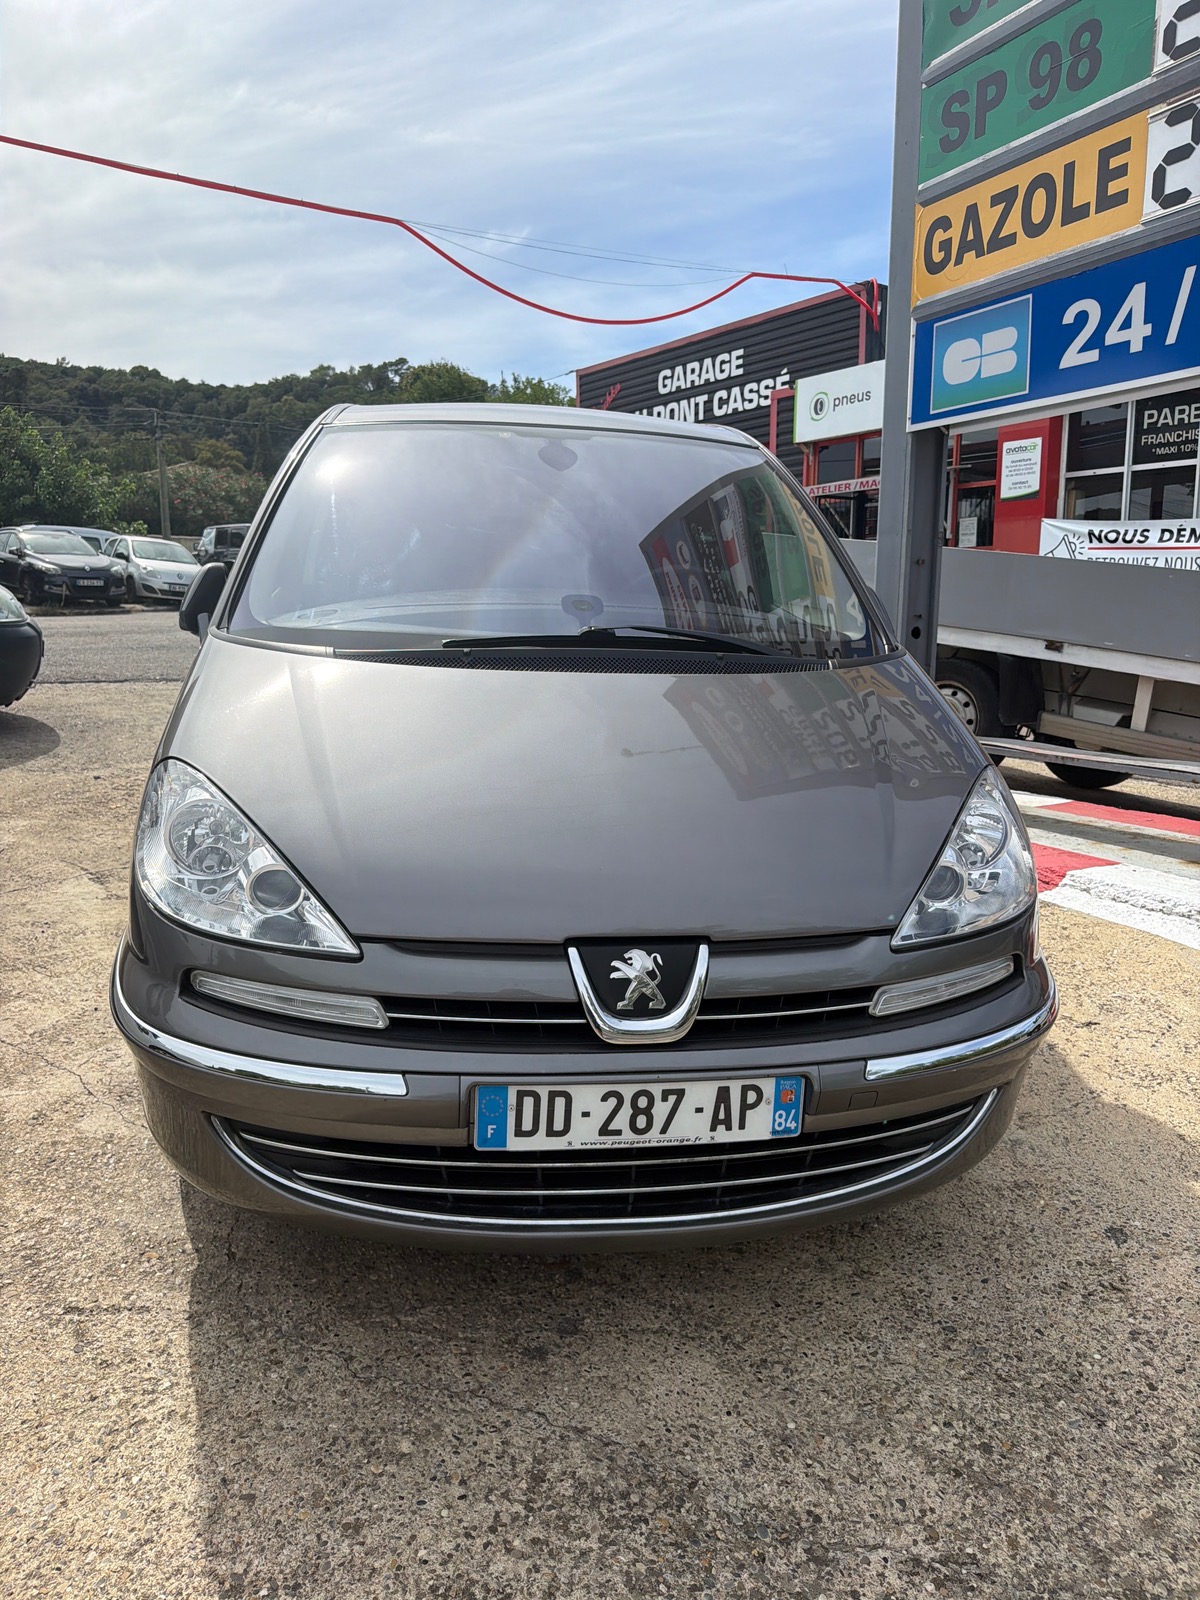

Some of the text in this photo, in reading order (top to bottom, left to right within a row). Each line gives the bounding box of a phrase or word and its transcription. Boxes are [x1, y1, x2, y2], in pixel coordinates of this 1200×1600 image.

[938, 18, 1103, 154] SP 98
[923, 136, 1133, 276] GAZOLE
[657, 348, 745, 395] GARAGE
[712, 367, 791, 418] CASSÉ
[832, 390, 872, 412] pneus
[1143, 403, 1200, 429] PARE
[808, 478, 881, 496] ATELIER /MA
[1087, 528, 1151, 544] NOUS
[774, 1109, 797, 1131] 84
[487, 1124, 497, 1139] F
[579, 1136, 704, 1147] www.peugeot-orange.fr
